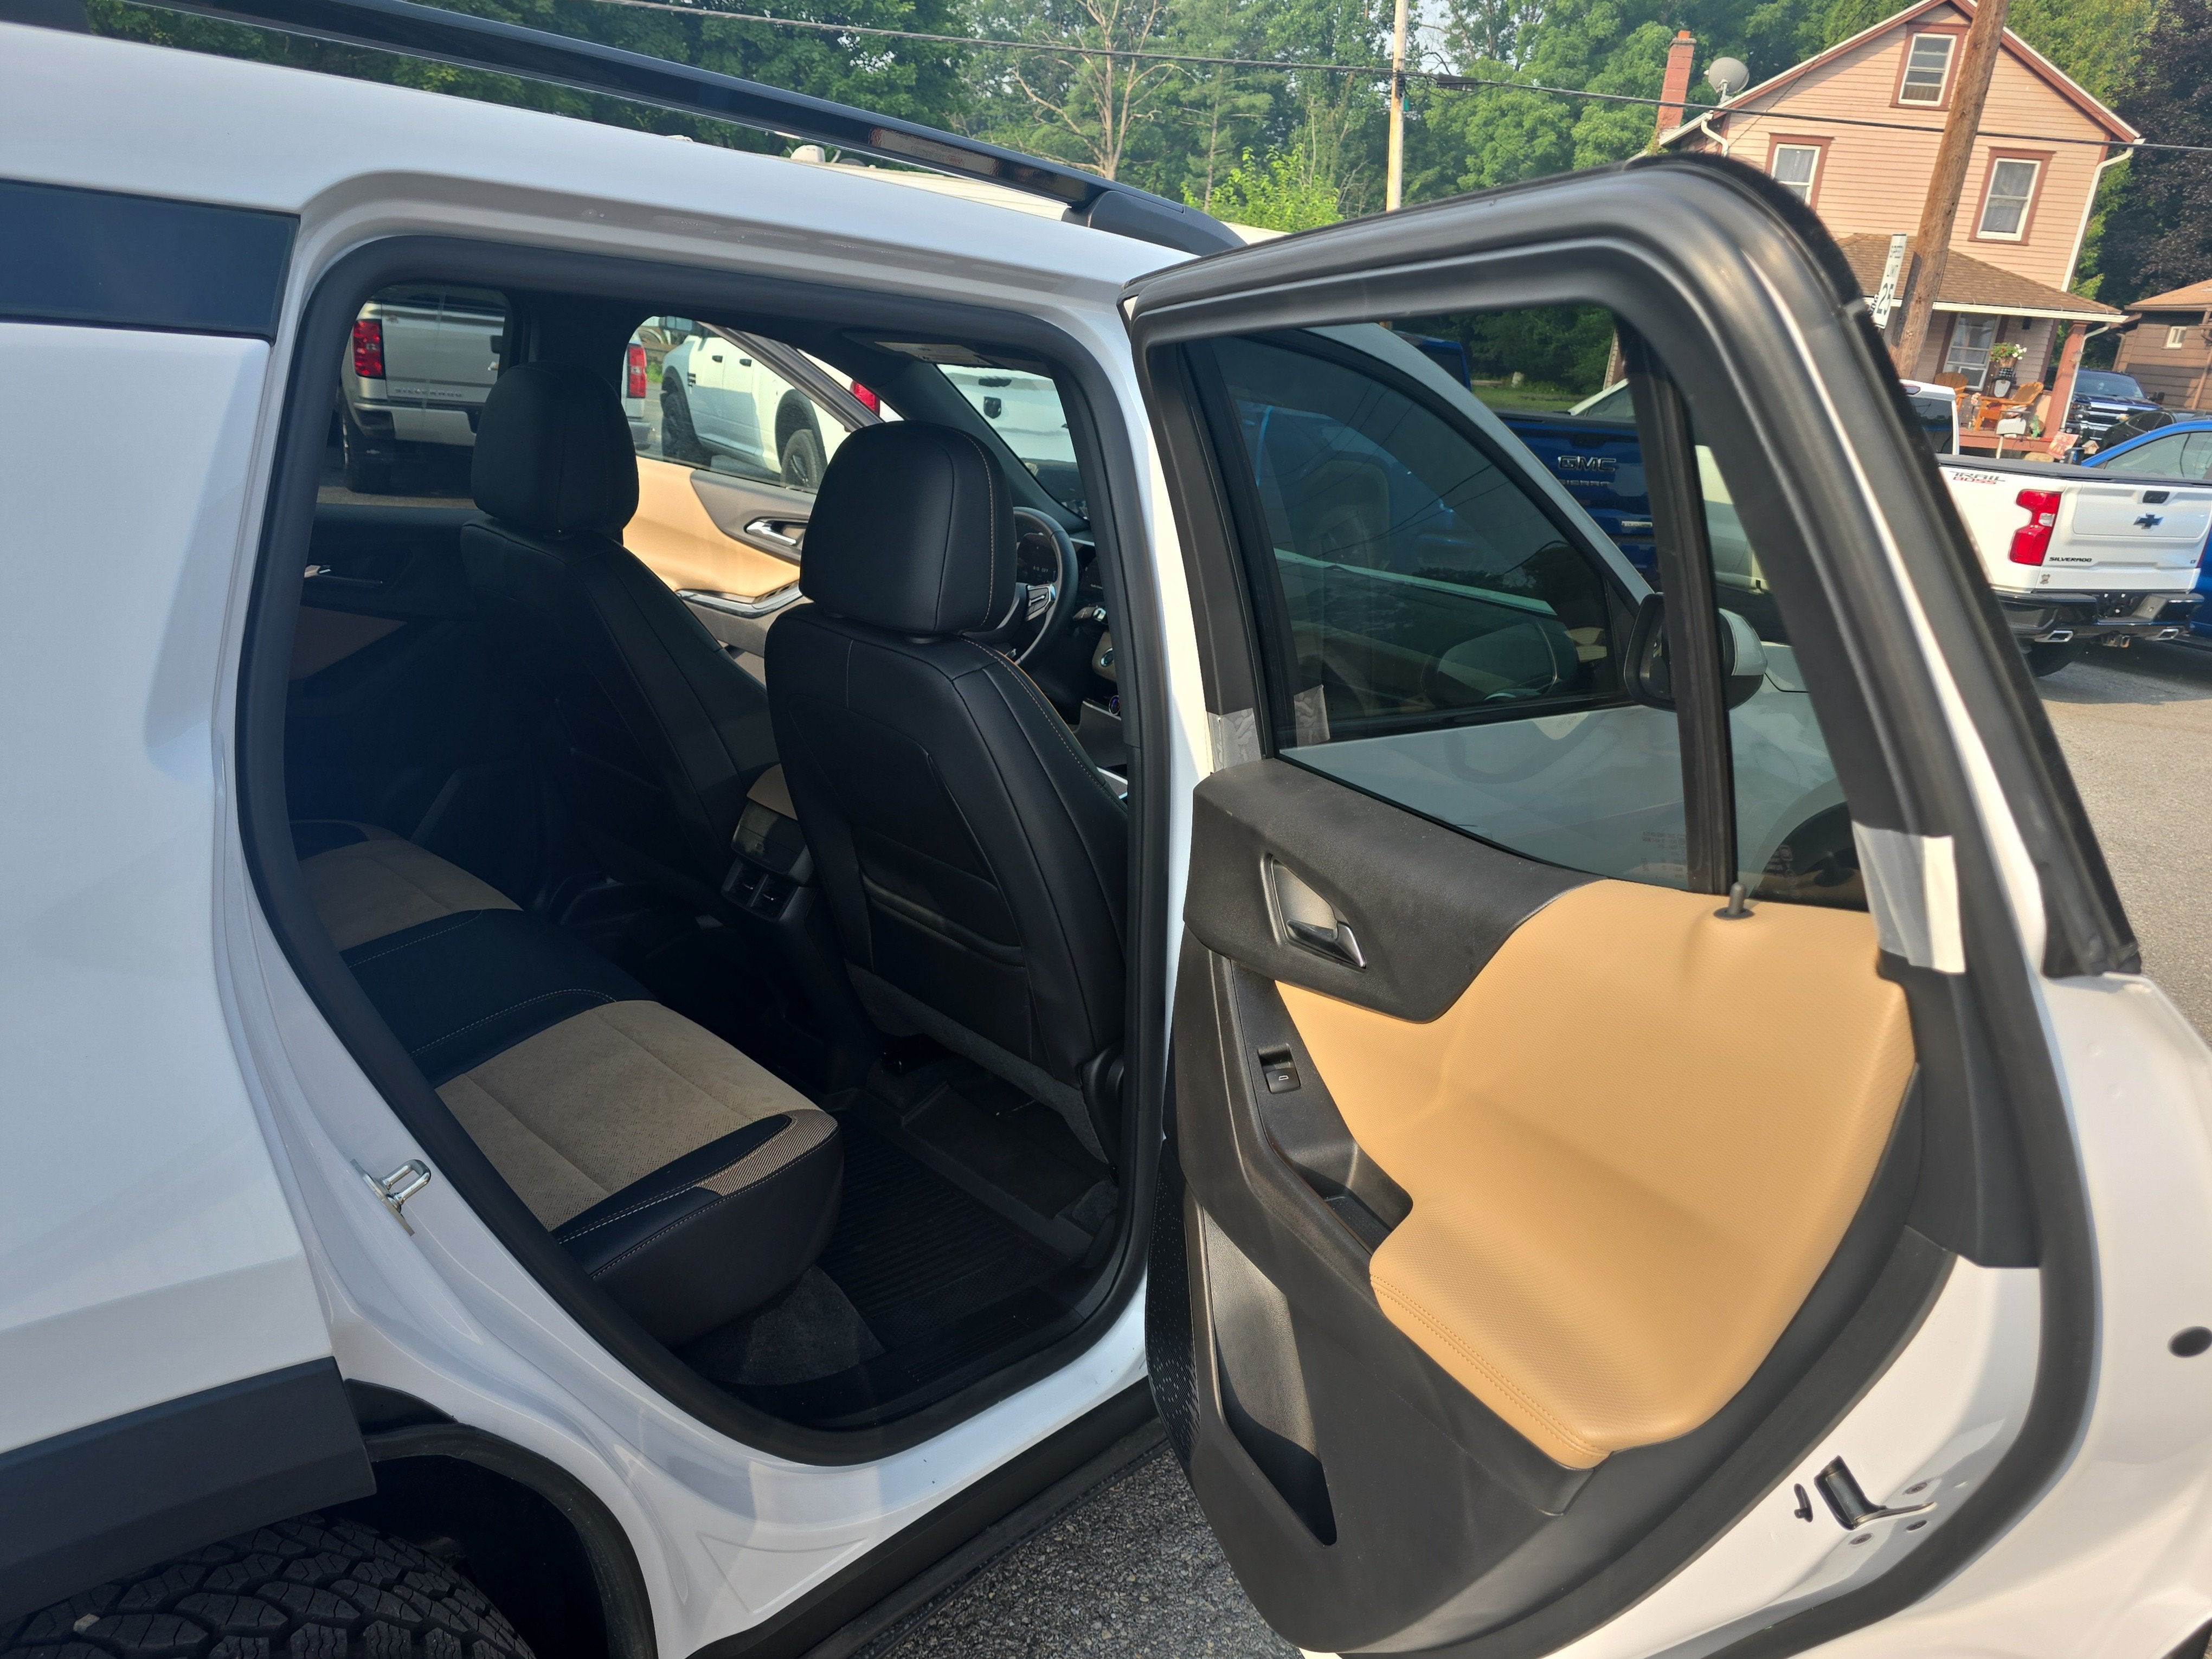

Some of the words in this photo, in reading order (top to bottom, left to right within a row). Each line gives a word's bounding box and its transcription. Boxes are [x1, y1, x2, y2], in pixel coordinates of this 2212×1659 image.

[1877, 283, 1894, 316] 25
[1558, 455, 1617, 472] GMC
[1949, 471, 2006, 482] TRAIL
[1952, 476, 1997, 485] BOSS
